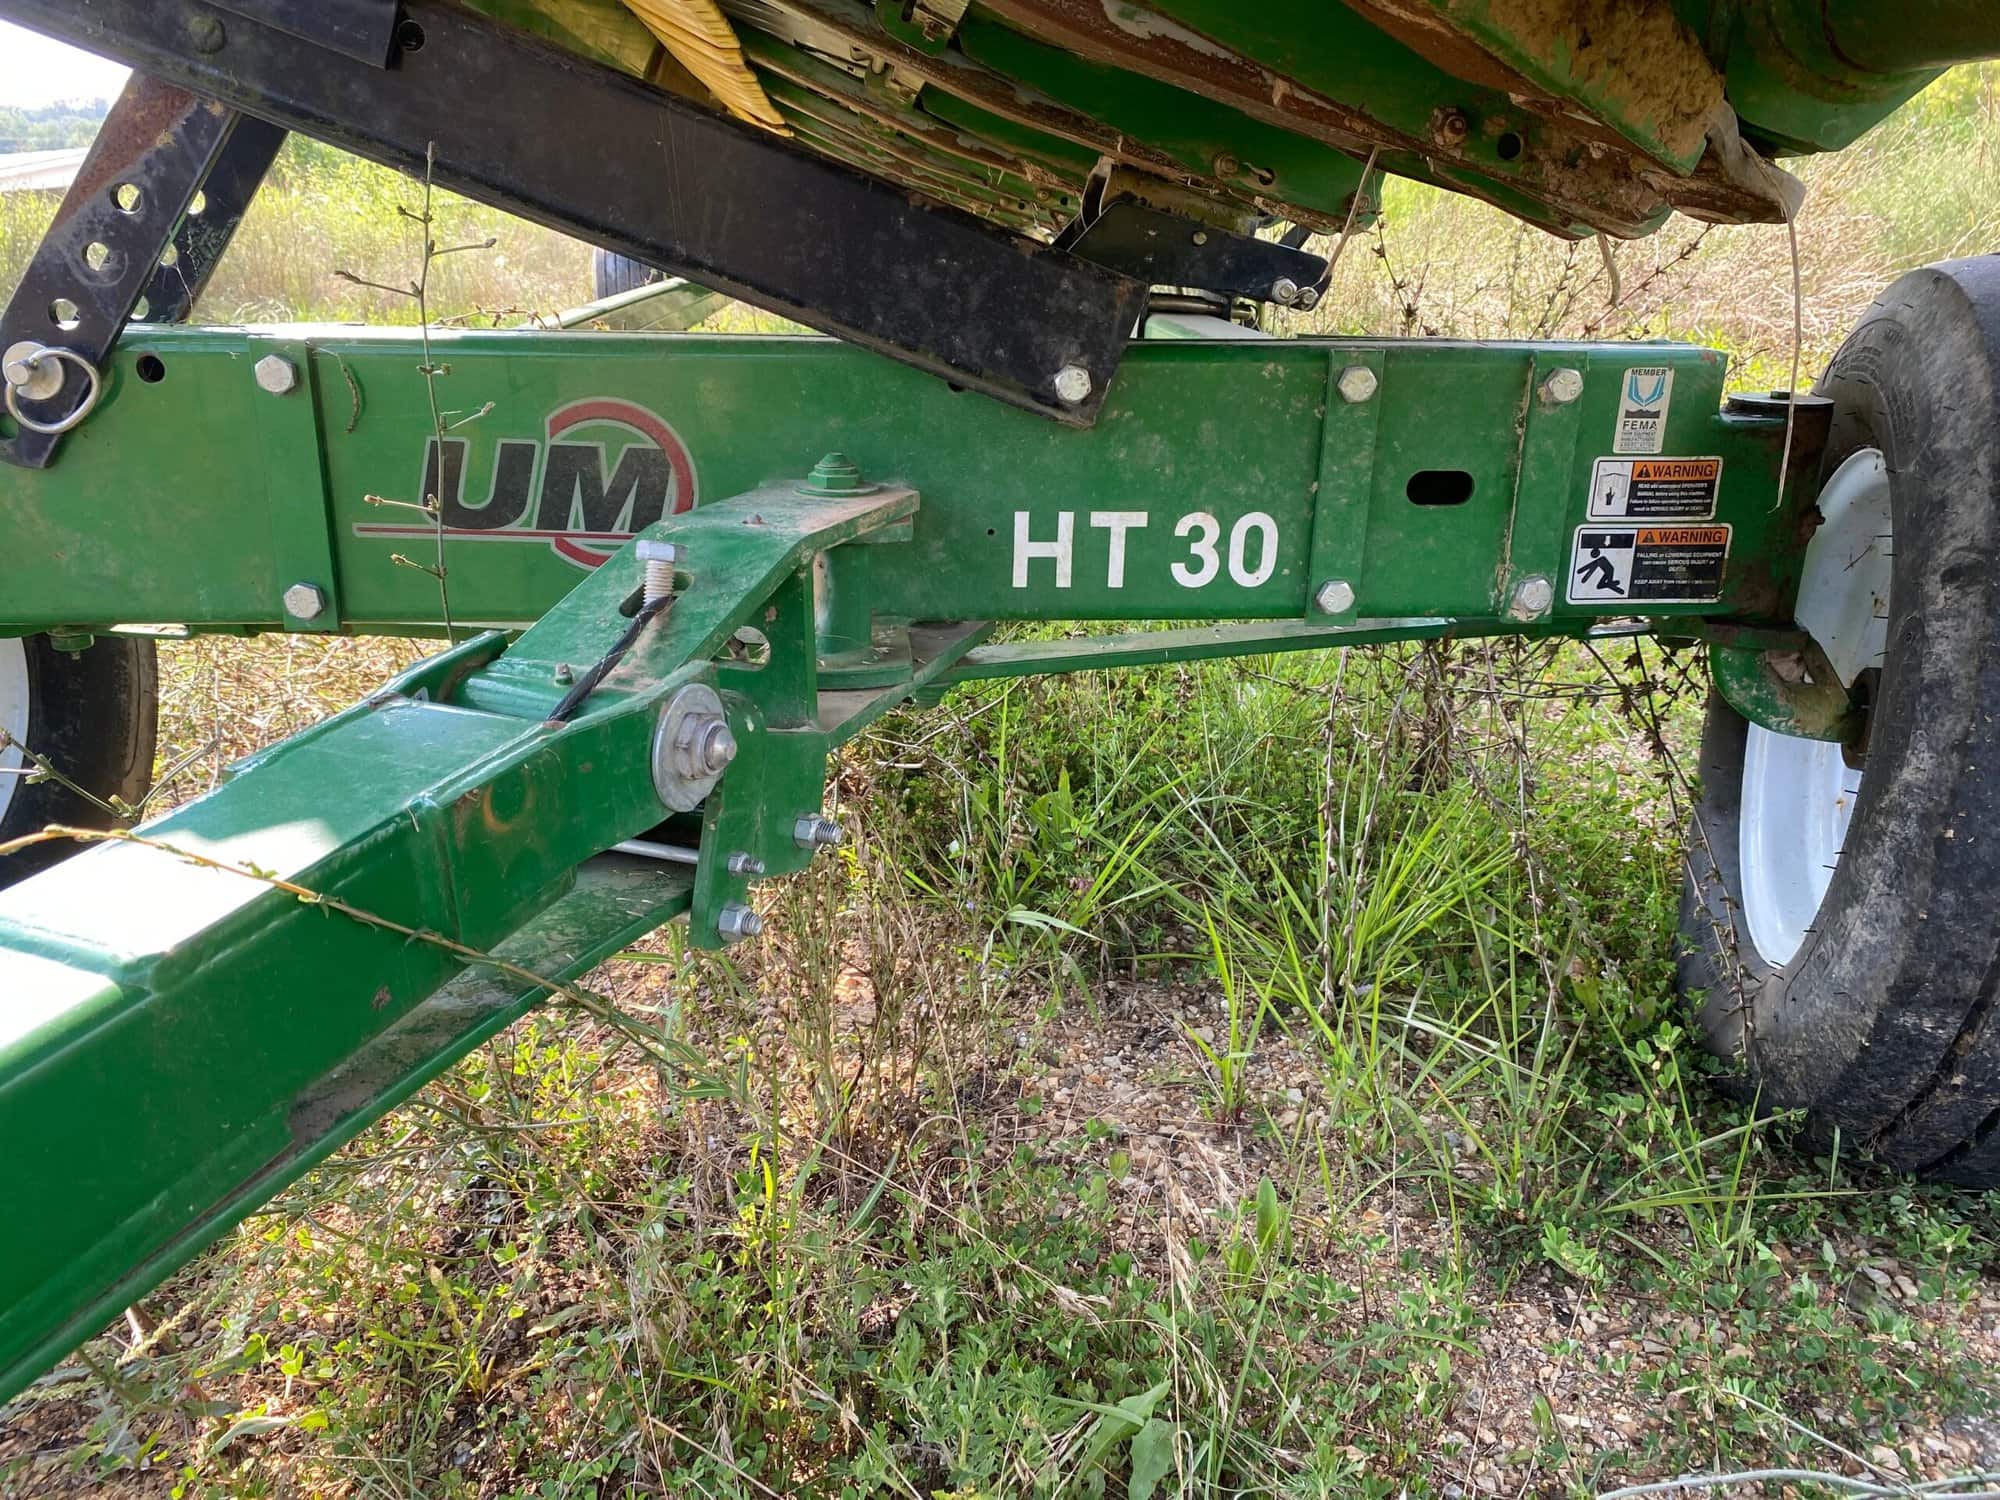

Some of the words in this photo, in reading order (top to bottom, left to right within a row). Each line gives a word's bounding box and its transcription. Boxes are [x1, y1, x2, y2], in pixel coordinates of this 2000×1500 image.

[1623, 420, 1657, 430] FEMA
[1653, 465, 1713, 477] WARNING
[1659, 531, 1722, 543] WARNING
[1012, 511, 1149, 588] HT
[1170, 511, 1279, 588] 30
